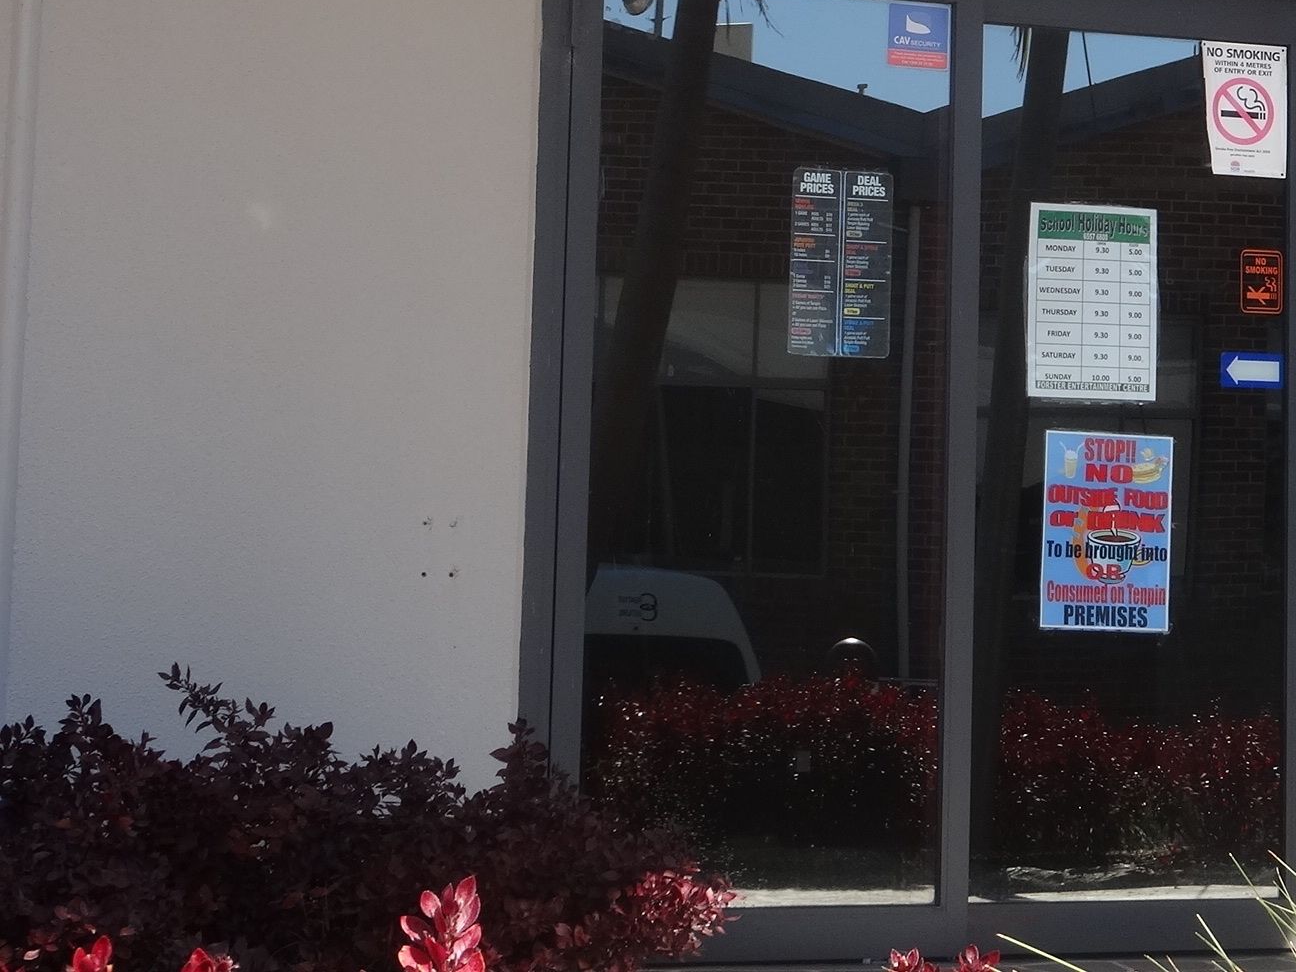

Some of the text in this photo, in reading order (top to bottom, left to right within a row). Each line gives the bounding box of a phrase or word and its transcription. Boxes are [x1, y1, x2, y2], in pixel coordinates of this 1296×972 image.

[894, 36, 910, 44] CAV
[1207, 48, 1280, 62] NO SMOKING
[804, 172, 831, 184] GAME
[858, 176, 881, 186] DEAL
[800, 182, 834, 194] PRICES
[852, 185, 885, 196] PRICES
[1040, 215, 1149, 237] School Holiday Hours
[1246, 266, 1278, 274] SMOKING
[1048, 330, 1070, 338] FRIDAY
[1037, 381, 1149, 392] FORSTER ENTERTAINMENT CENTRE
[1084, 438, 1136, 462] STOP!!
[1086, 464, 1133, 484] NO
[1048, 484, 1168, 510] OUTSIDE FOOD
[1087, 510, 1166, 533] DRINK
[1047, 540, 1167, 563] To be brought into
[1086, 564, 1122, 580] OR
[1047, 580, 1165, 607] Consumed on Tenpin
[1064, 605, 1147, 627] PREMISES
